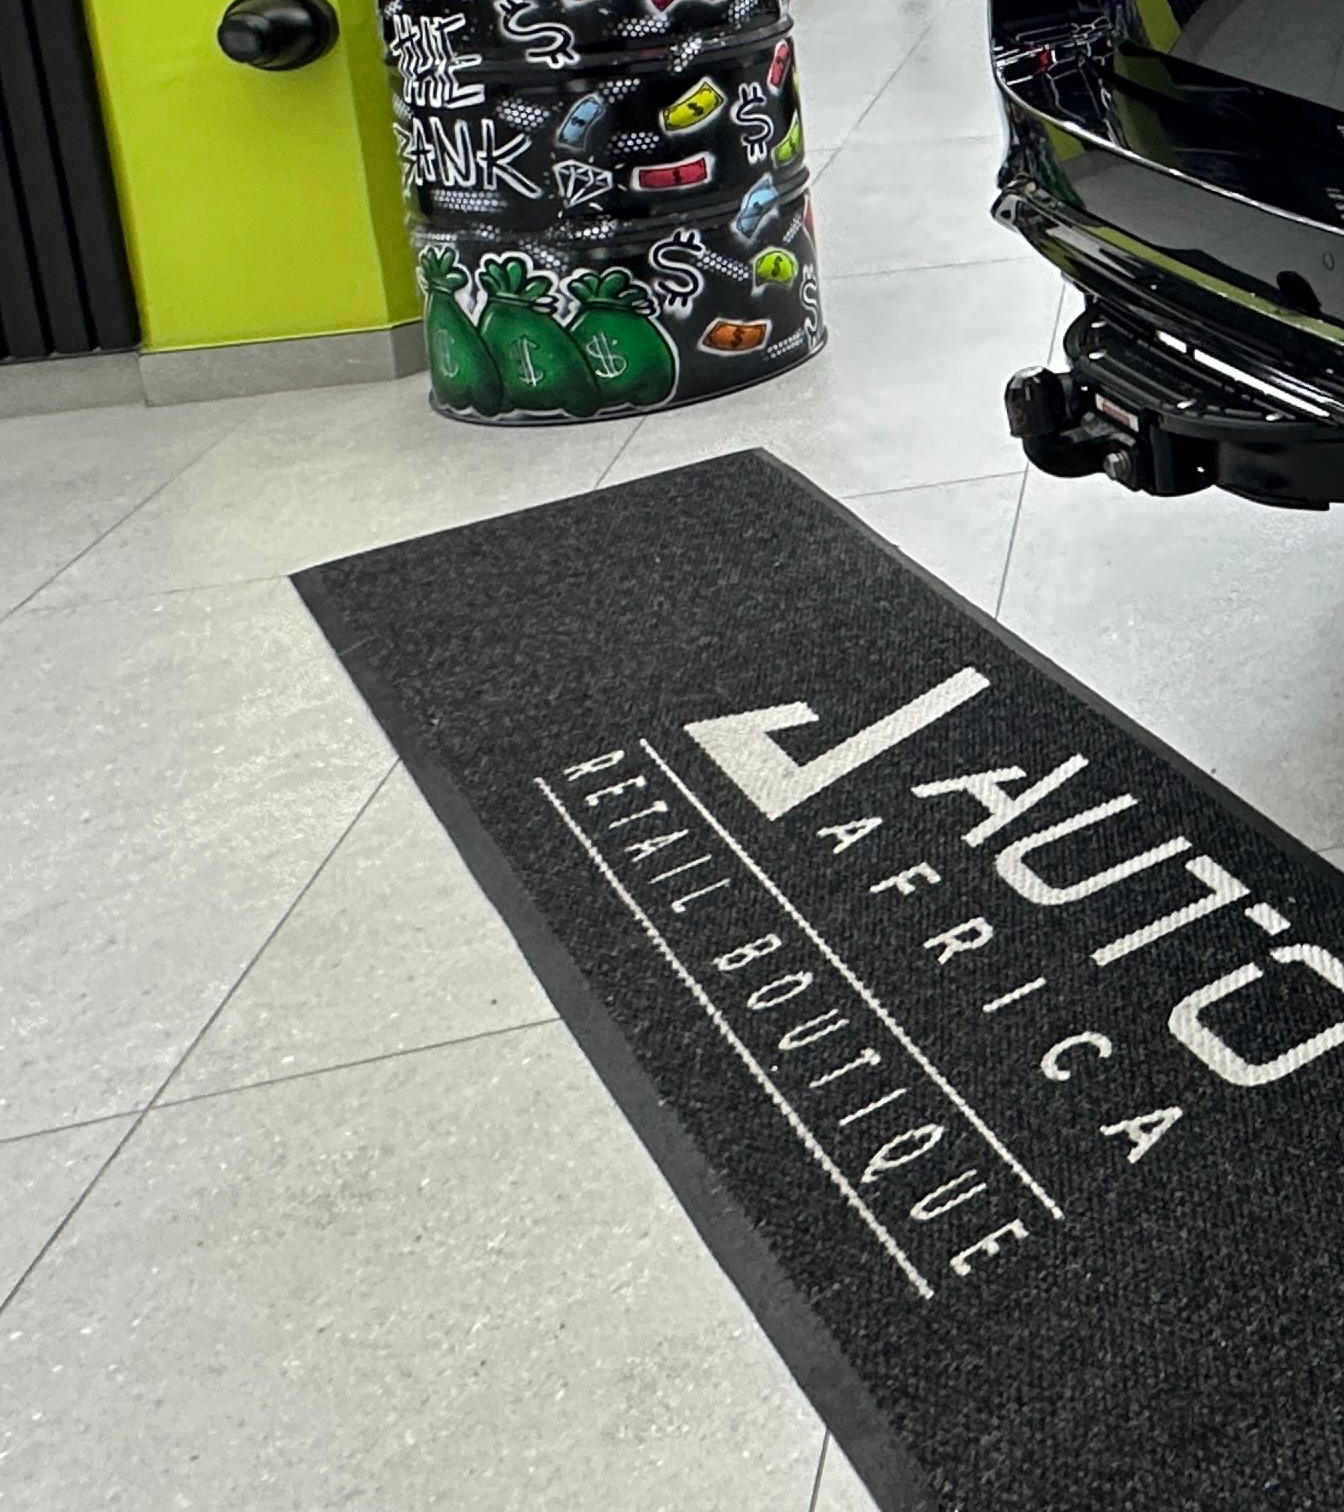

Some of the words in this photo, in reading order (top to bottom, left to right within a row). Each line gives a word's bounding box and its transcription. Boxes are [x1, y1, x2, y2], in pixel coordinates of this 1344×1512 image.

[563, 749, 731, 913] RETAIL
[713, 932, 1029, 1276] BOUTIQUE
[817, 814, 1183, 1163] AFRICA
